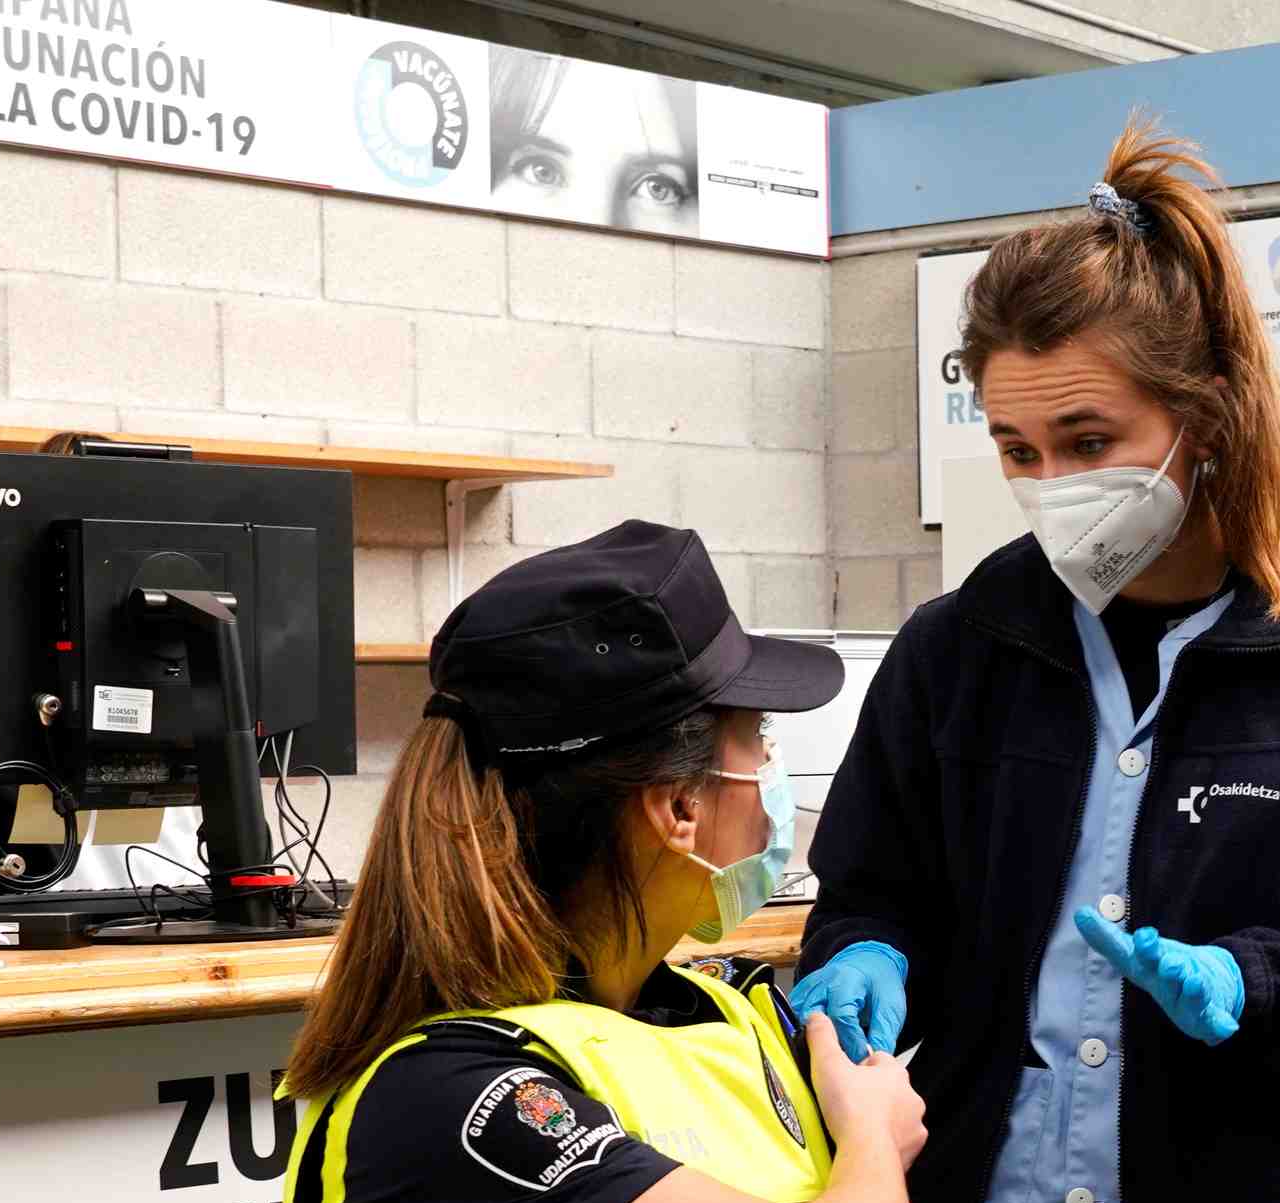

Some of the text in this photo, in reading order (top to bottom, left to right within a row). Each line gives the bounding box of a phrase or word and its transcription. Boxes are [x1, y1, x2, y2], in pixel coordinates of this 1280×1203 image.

[51, 88, 256, 156] COVID-19
[1209, 782, 1280, 801] Osakidetza
[469, 1082, 514, 1137] GUARDIA
